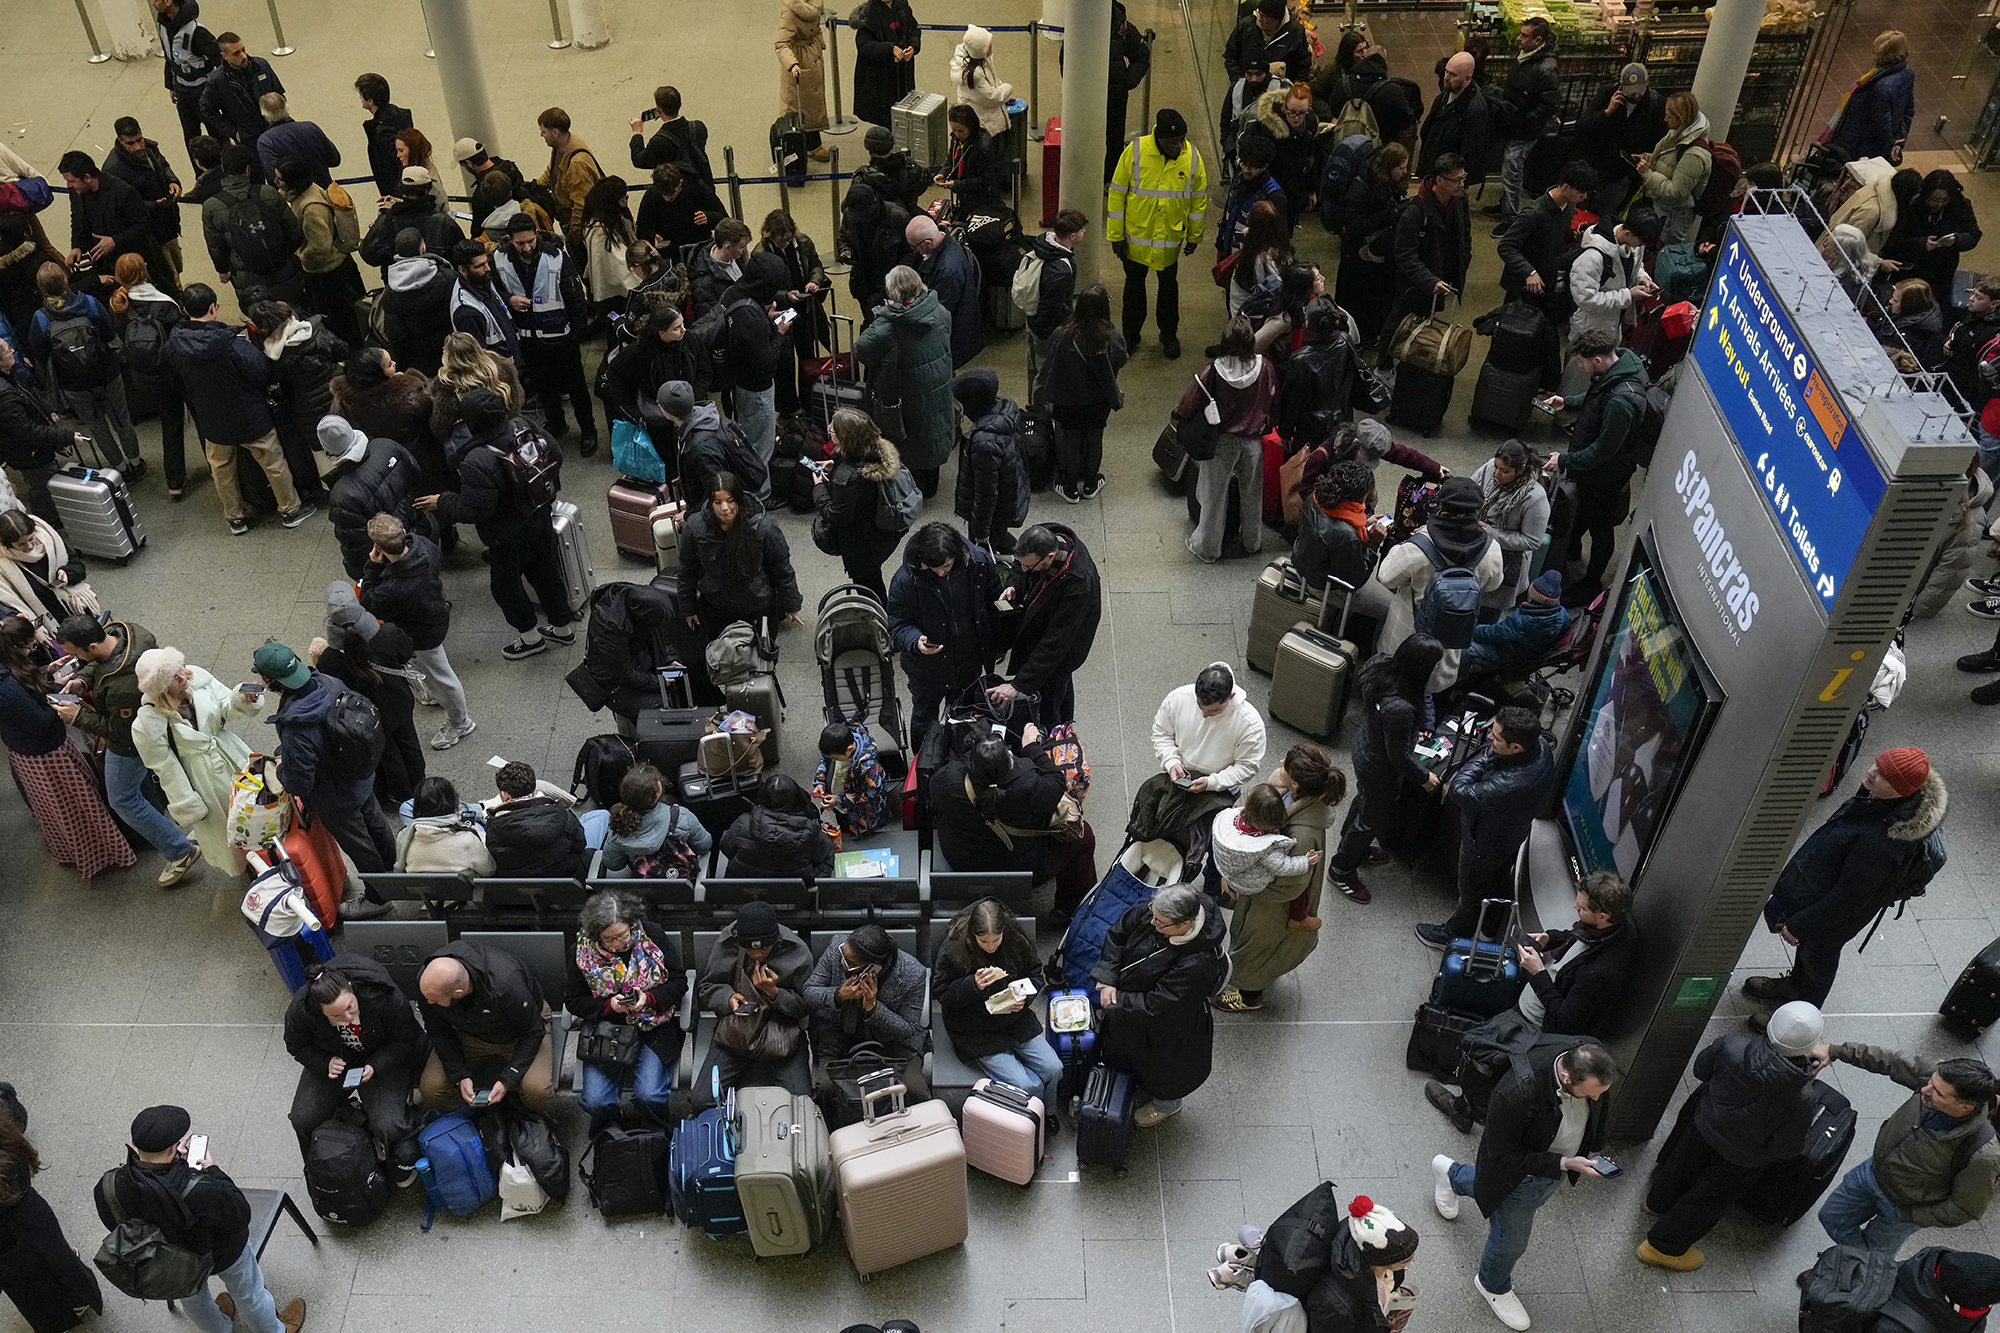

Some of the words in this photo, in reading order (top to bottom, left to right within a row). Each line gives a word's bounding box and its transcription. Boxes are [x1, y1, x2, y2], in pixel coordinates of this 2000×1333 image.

[1739, 259, 1795, 360] Underground
[1718, 324, 1736, 366] Way
[1734, 360, 1750, 390] out
[1748, 388, 1762, 417] Euston
[1761, 412, 1773, 435] Road
[1728, 295, 1761, 357] Arrivals
[1759, 350, 1796, 419] Arrivées
[1804, 432, 1828, 471] eurostar
[1811, 373, 1844, 432] Pre-registration
[1832, 431, 1840, 445] C
[1685, 476, 1760, 632] Pancras
[1788, 505, 1820, 573] Toilets
[1635, 574, 1651, 615] Find
[1647, 603, 1659, 636] the
[1656, 629, 1669, 662] one
[1666, 653, 1682, 694] with
[1697, 562, 1740, 647] INTERNATIONAL
[1637, 622, 1652, 662] Fine
[1648, 651, 1668, 702] Wines
